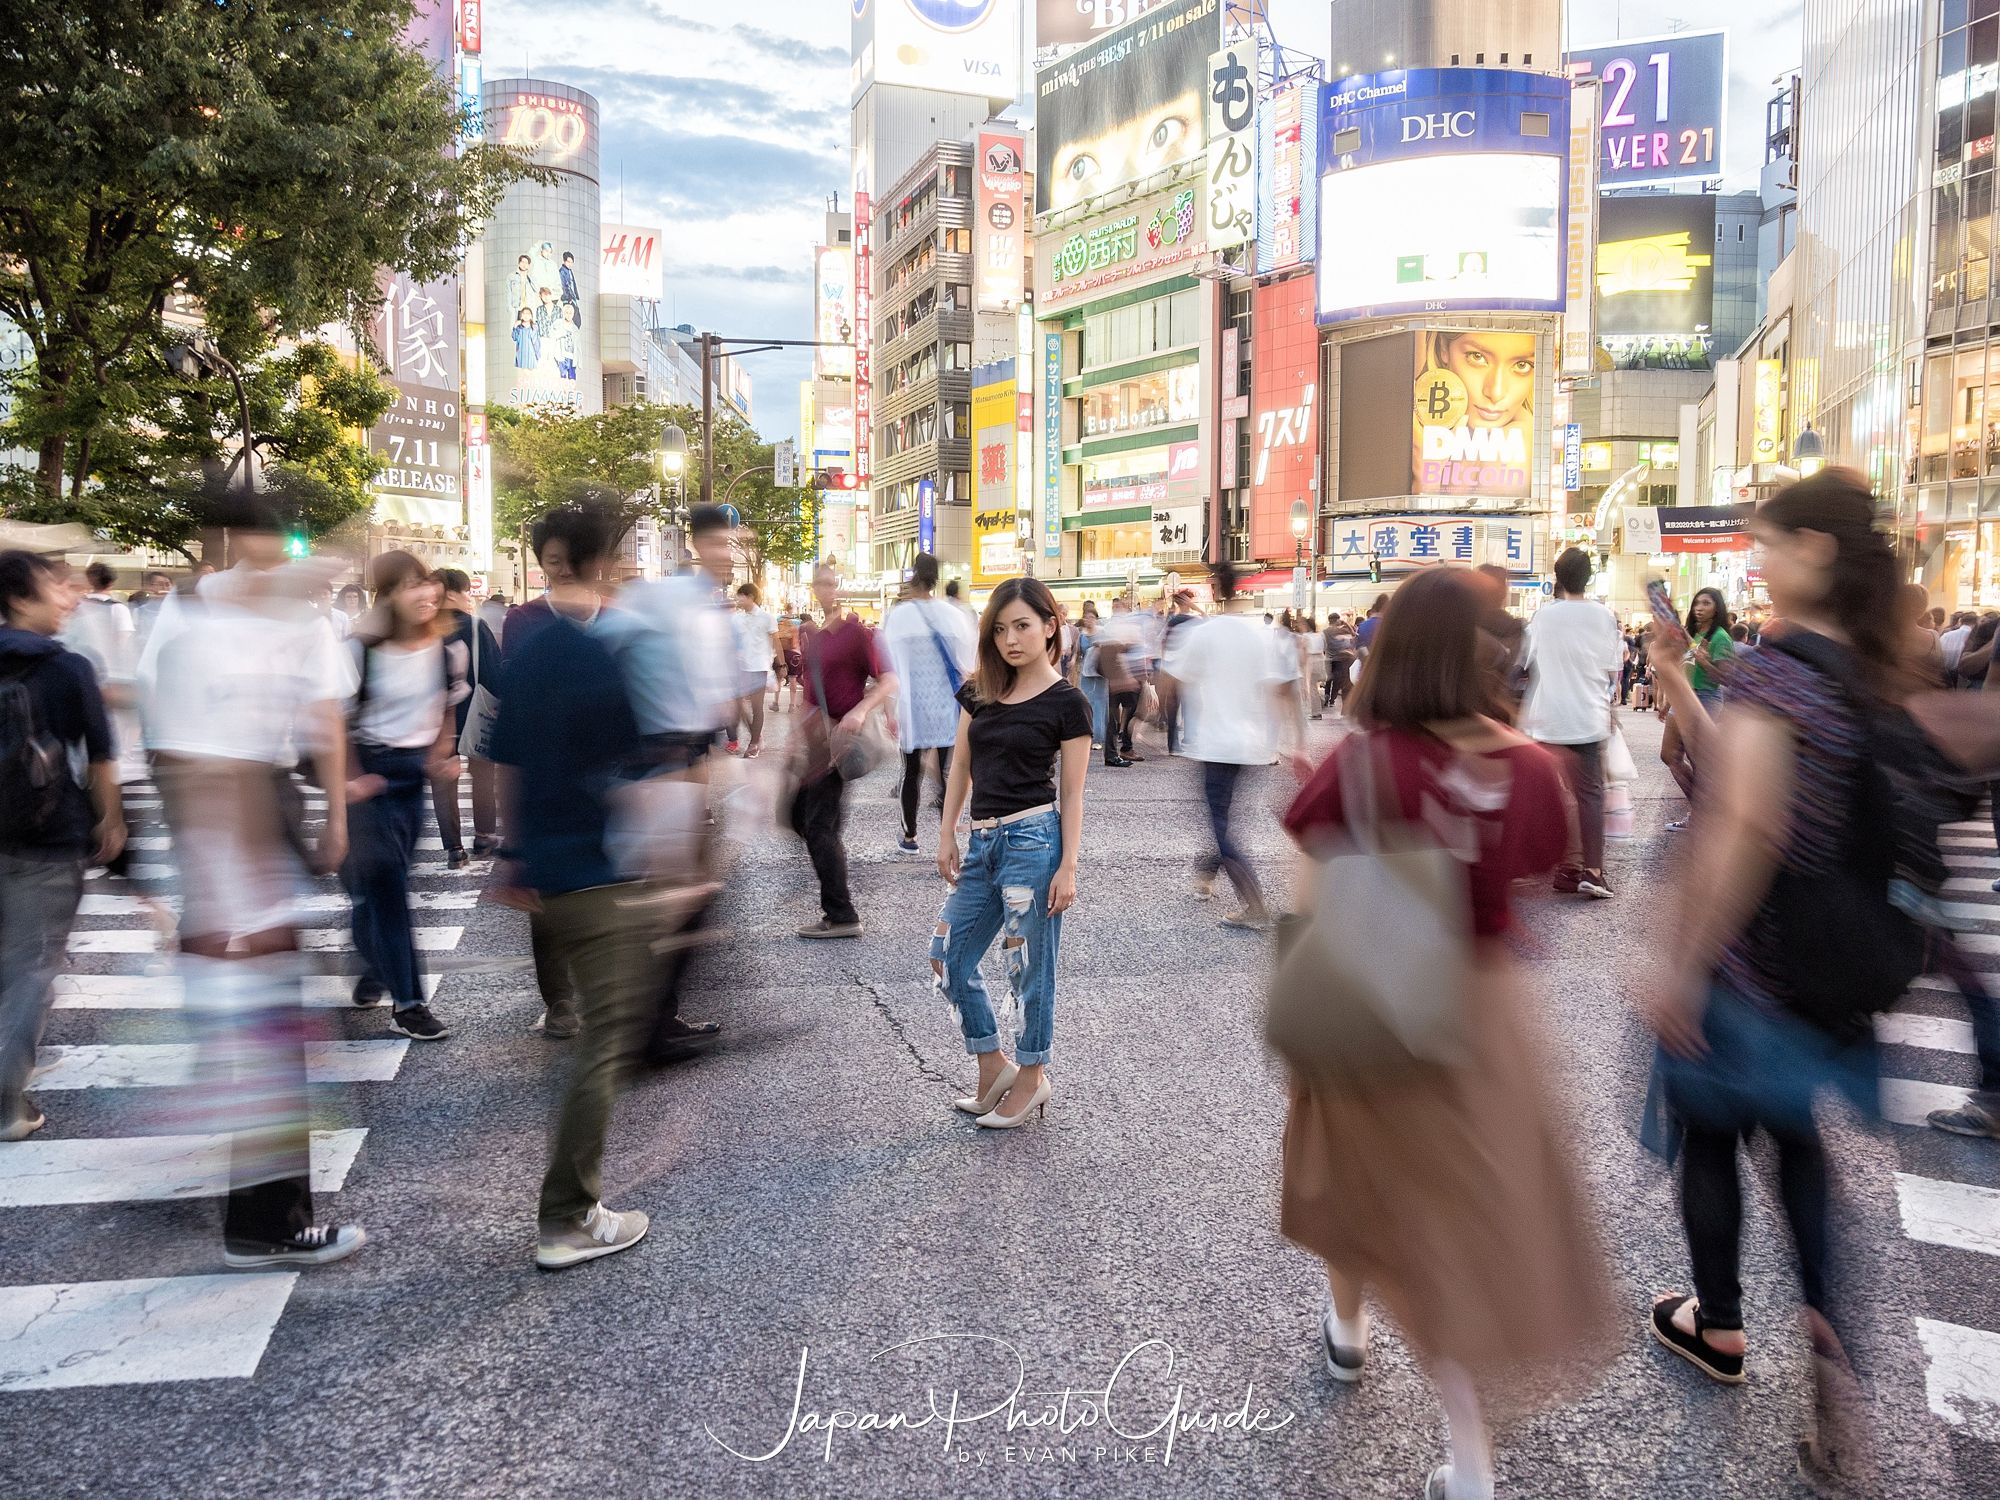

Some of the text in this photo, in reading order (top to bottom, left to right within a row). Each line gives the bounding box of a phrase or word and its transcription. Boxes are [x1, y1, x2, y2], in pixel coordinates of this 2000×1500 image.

[1041, 0, 1216, 97] miwa THE BEST 7/11 on sale
[963, 58, 1001, 76] VISA
[518, 95, 583, 115] SHIBUYA
[1330, 80, 1406, 108] DHC Channel
[501, 105, 586, 160] 109
[1401, 111, 1475, 142] DHC
[1211, 52, 1253, 236] もんじゃ
[1680, 128, 1713, 164] 21
[602, 233, 654, 269] H&M
[1088, 228, 1138, 270] 西村
[1425, 301, 1447, 310] DHC
[1087, 406, 1166, 434] Euphoria
[1255, 384, 1315, 486] クスリ
[389, 434, 441, 468] 7.11
[1422, 424, 1526, 462] DMM
[374, 467, 456, 495] RELEASE
[782, 446, 791, 484] 渋谷駅前
[1423, 461, 1525, 488] Bitcoin
[1342, 526, 1522, 560] 大盛堂書店
